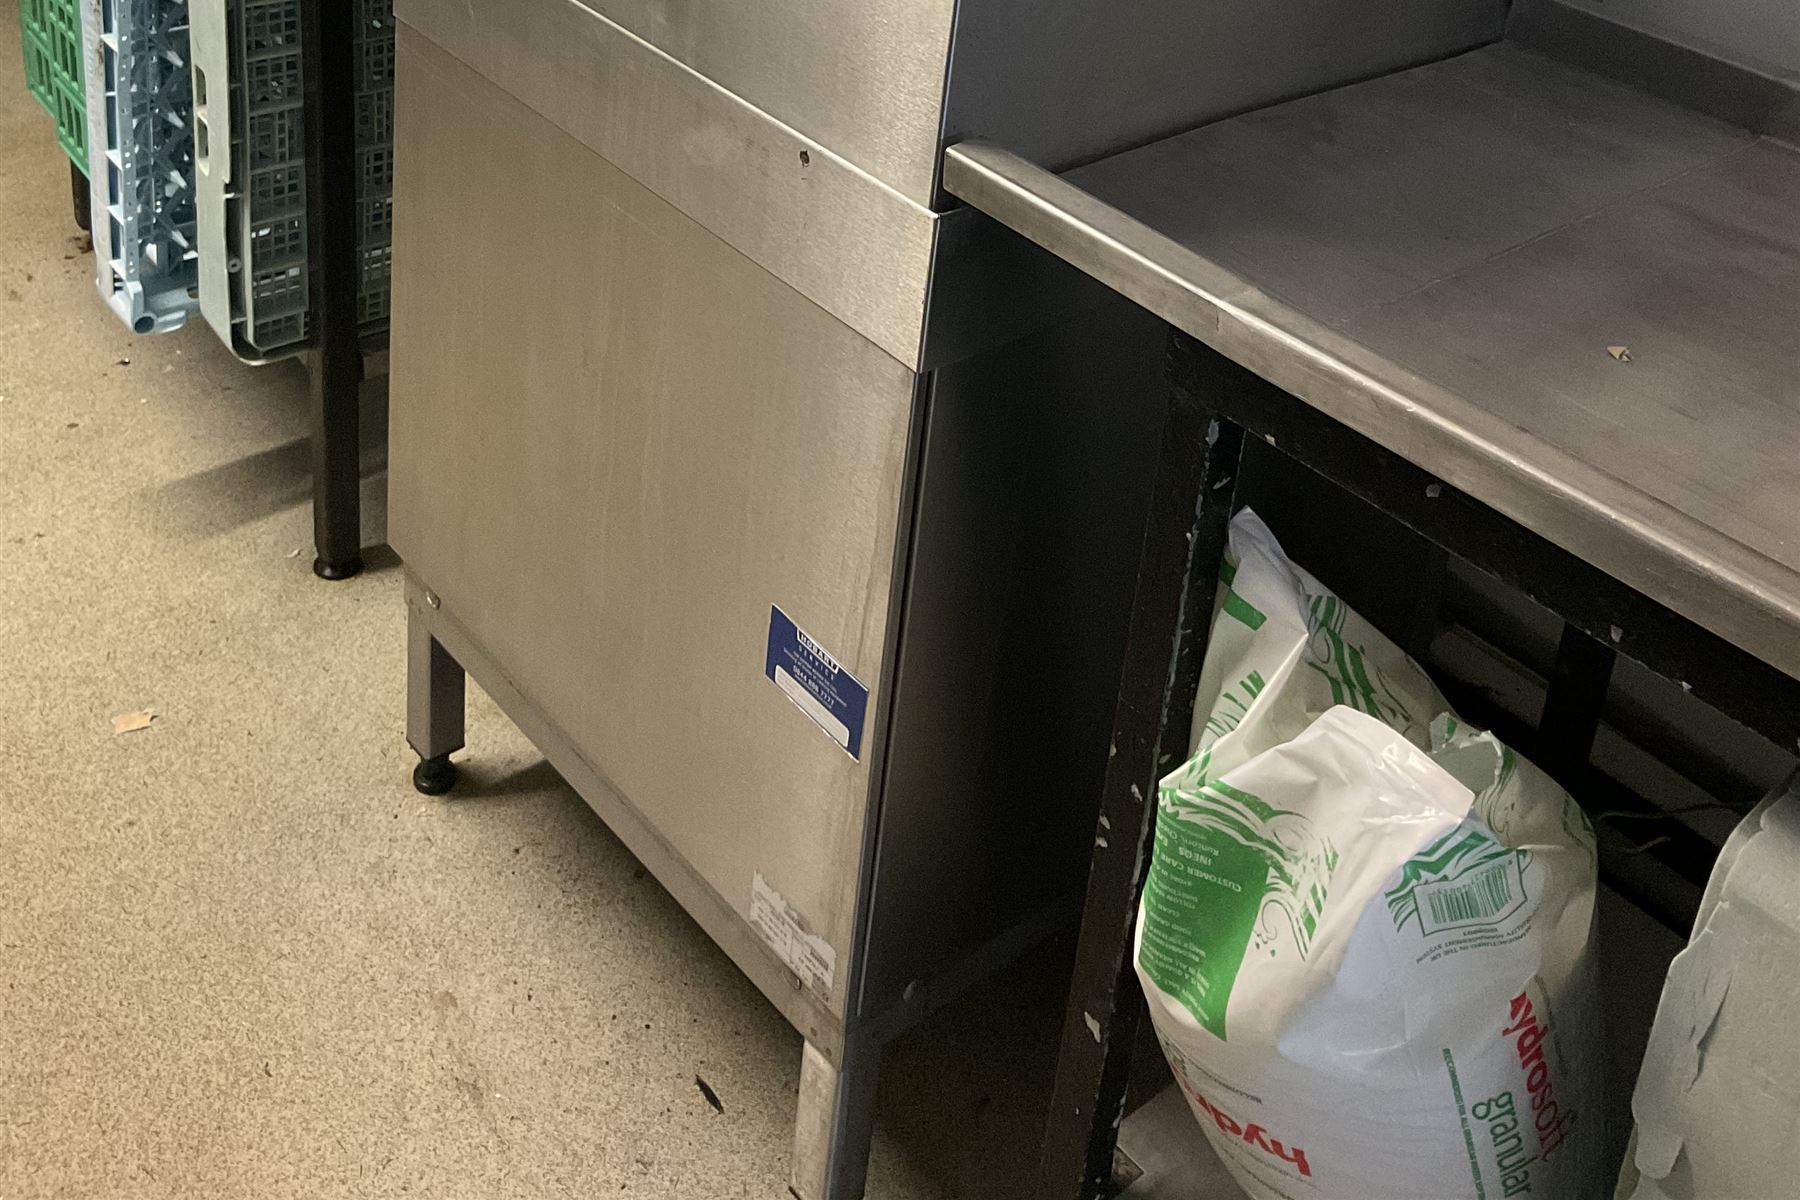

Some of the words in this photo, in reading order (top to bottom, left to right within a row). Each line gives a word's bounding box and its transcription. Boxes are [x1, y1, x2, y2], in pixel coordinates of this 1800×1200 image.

[799, 645, 835, 681] SERVICE
[800, 633, 838, 670] HOBART
[1161, 852, 1184, 871] CARE
[1178, 846, 1212, 867] INEOS
[1187, 866, 1242, 892] CUSTOMER
[1472, 1091, 1532, 1199] granular
